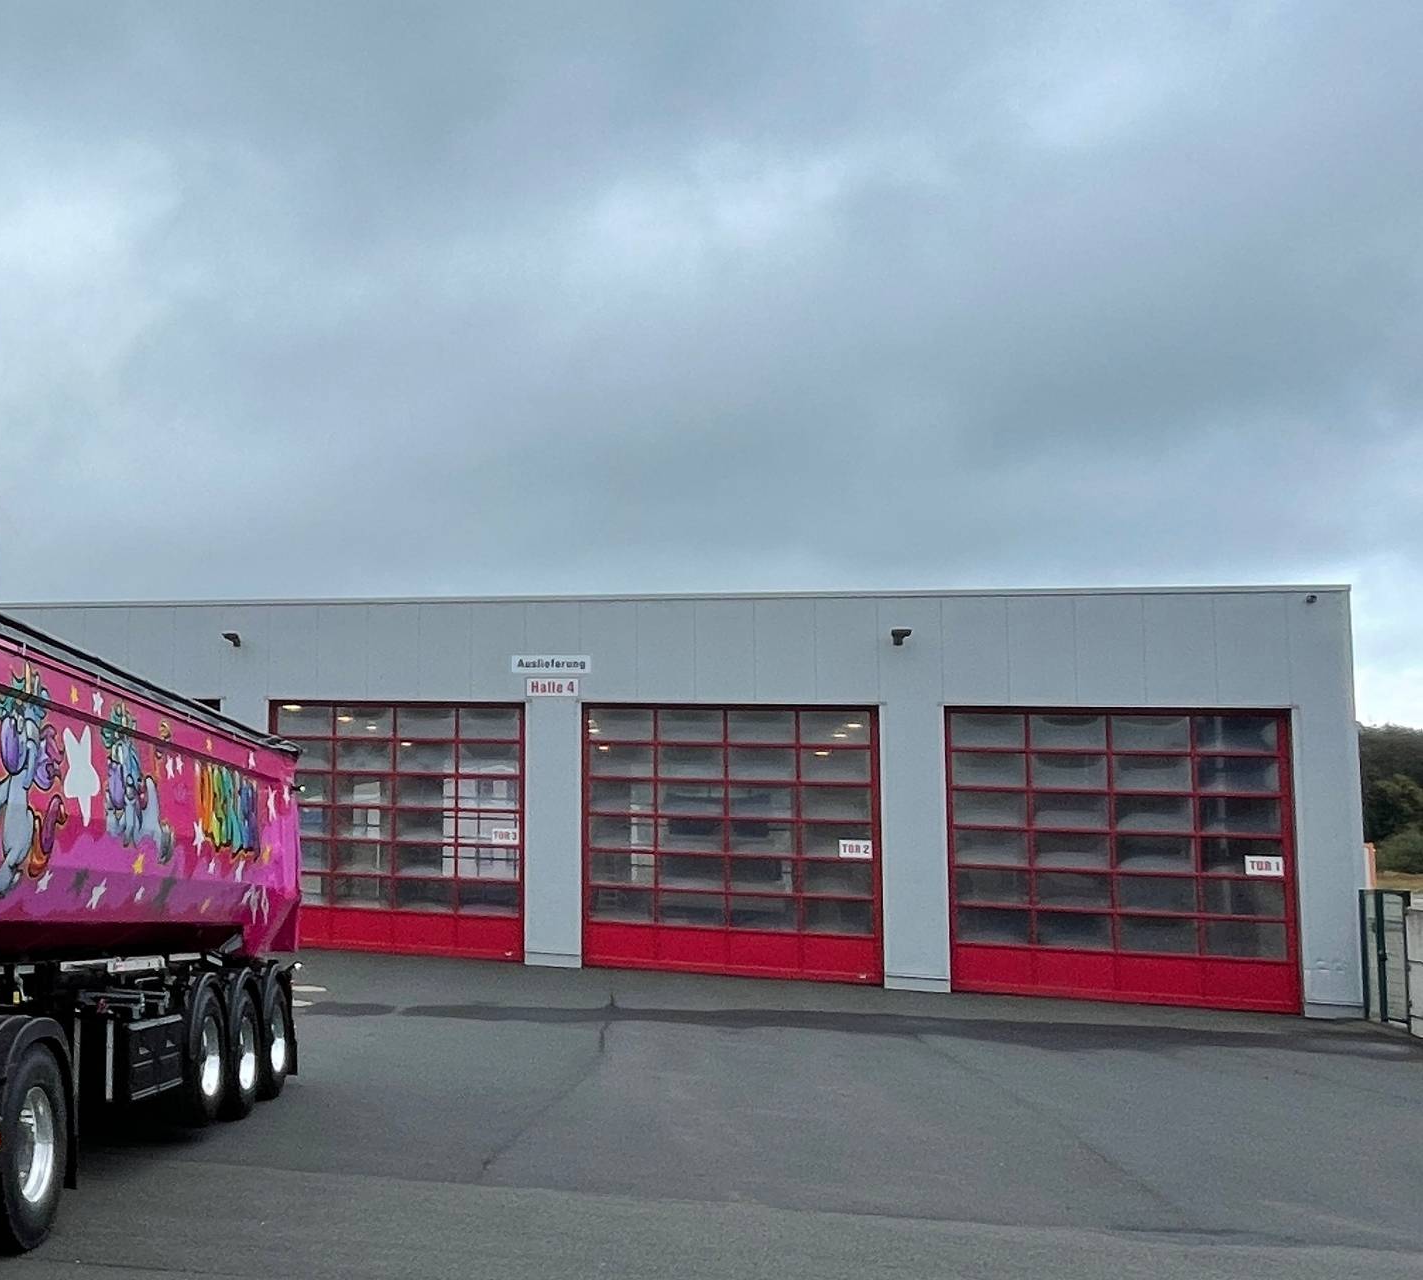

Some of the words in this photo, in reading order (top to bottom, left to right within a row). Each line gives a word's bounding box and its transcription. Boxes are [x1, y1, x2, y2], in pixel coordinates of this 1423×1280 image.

[517, 658, 587, 670] Auslieferung
[531, 681, 564, 694] Halle
[567, 681, 575, 694] 4
[493, 830, 510, 841] TOR
[842, 843, 861, 854] TOR
[862, 844, 870, 855] 2
[1249, 860, 1272, 872] TOR
